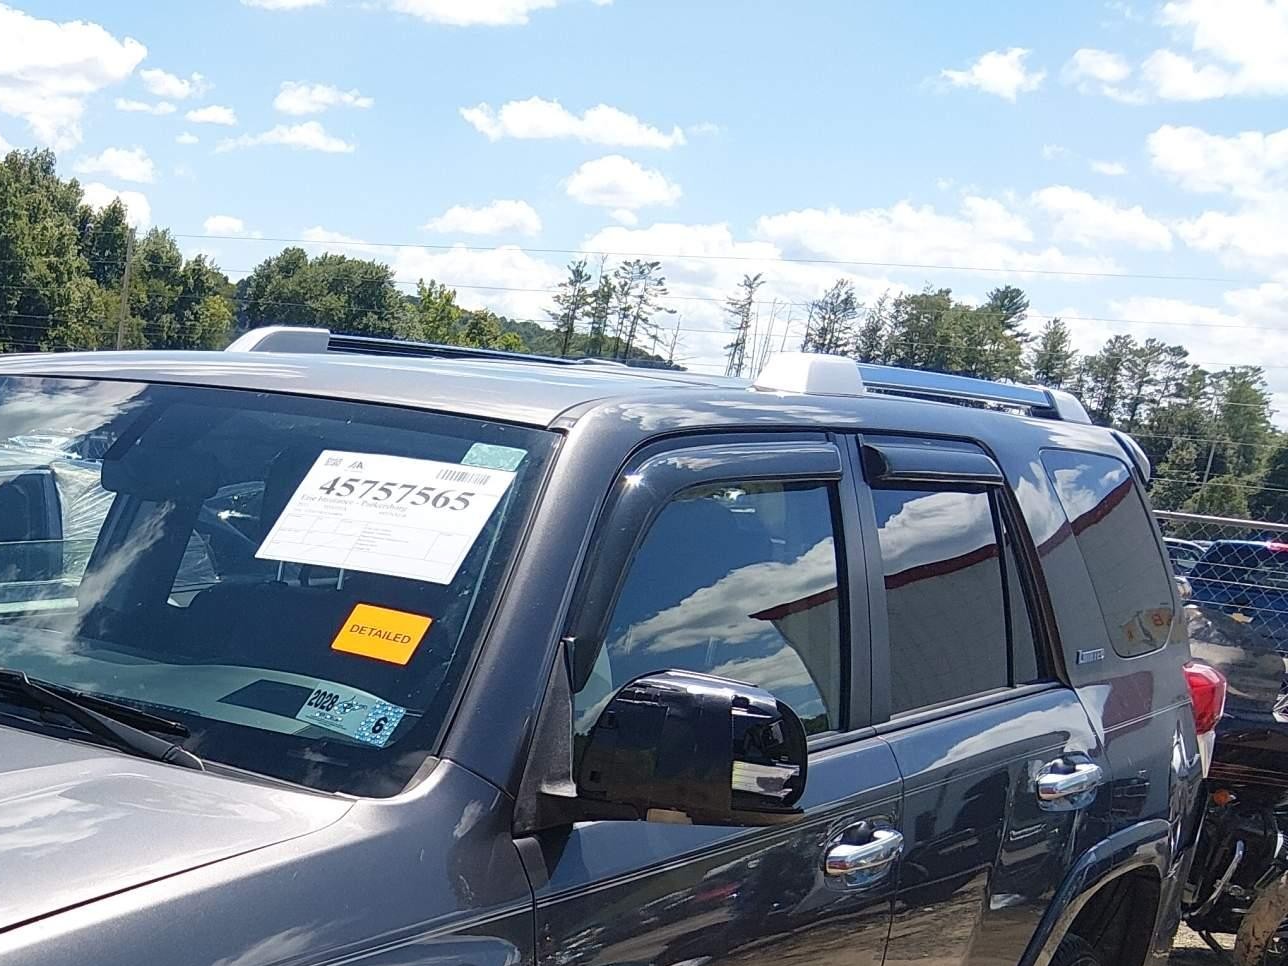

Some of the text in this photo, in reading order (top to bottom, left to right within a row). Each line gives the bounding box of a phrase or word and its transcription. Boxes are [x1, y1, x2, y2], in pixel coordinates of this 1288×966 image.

[318, 476, 476, 511] 45757565
[349, 624, 412, 644] DETAILED
[307, 689, 339, 712] 2028
[372, 716, 388, 734] 6
